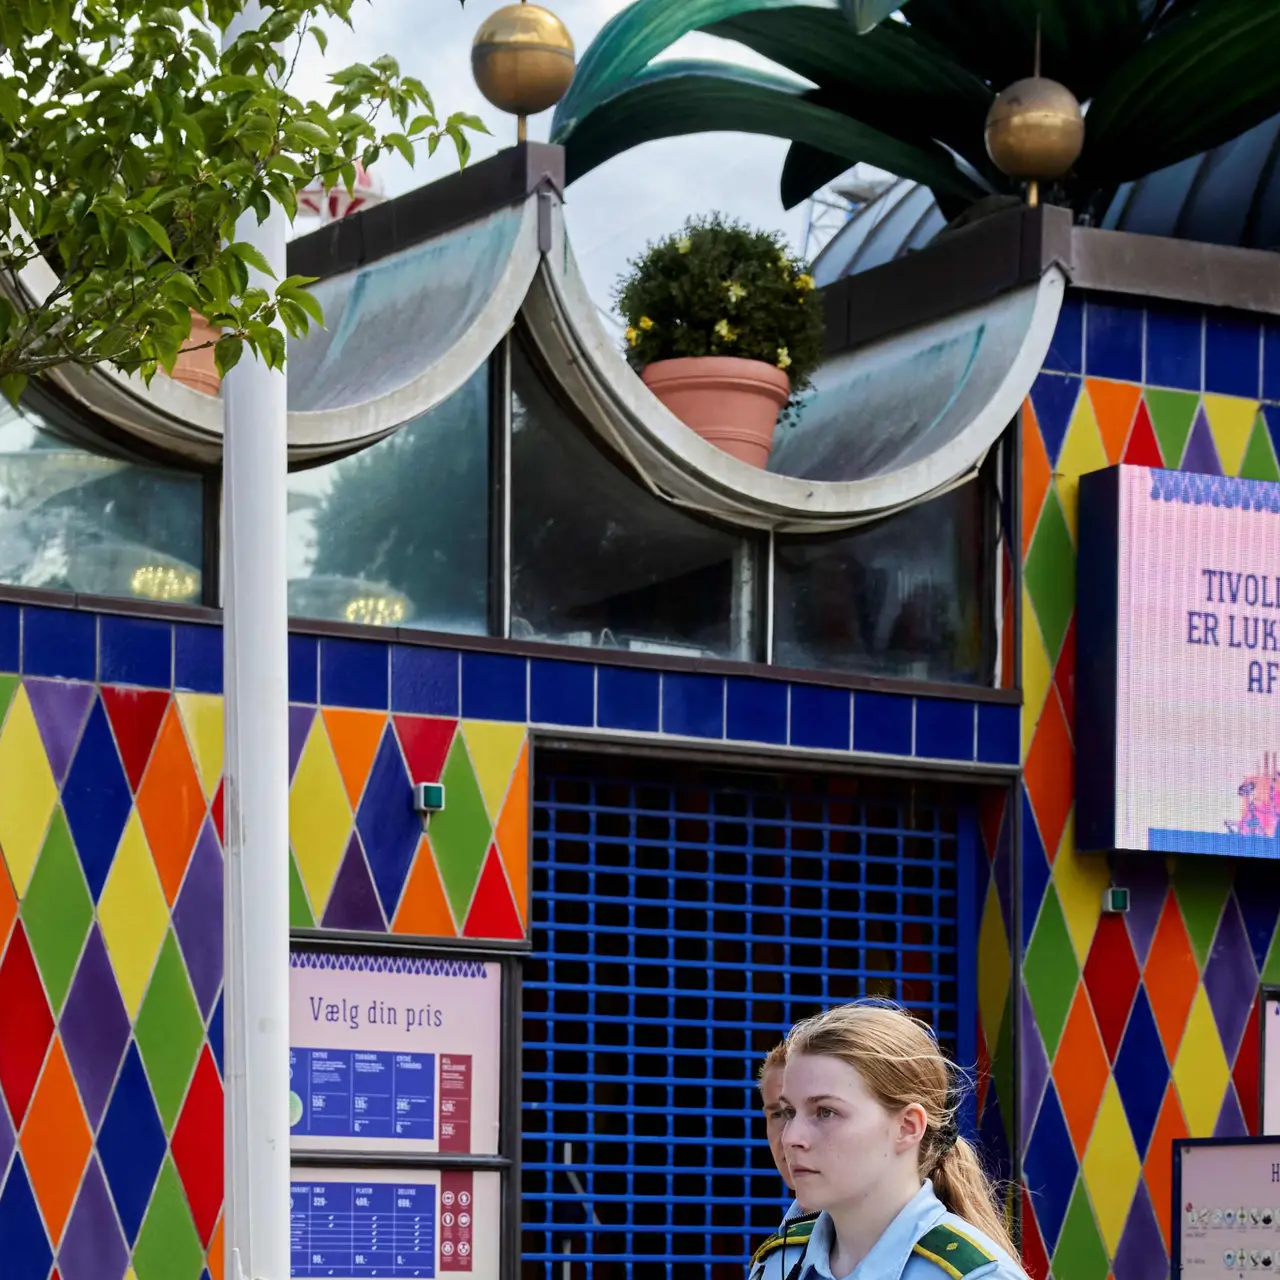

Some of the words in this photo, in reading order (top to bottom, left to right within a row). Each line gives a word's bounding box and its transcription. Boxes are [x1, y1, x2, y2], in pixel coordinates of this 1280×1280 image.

[1186, 611, 1220, 646] ER
[1247, 660, 1280, 694] AF
[309, 996, 360, 1030] Vælg
[367, 1000, 398, 1025] din
[406, 1004, 443, 1032] pris
